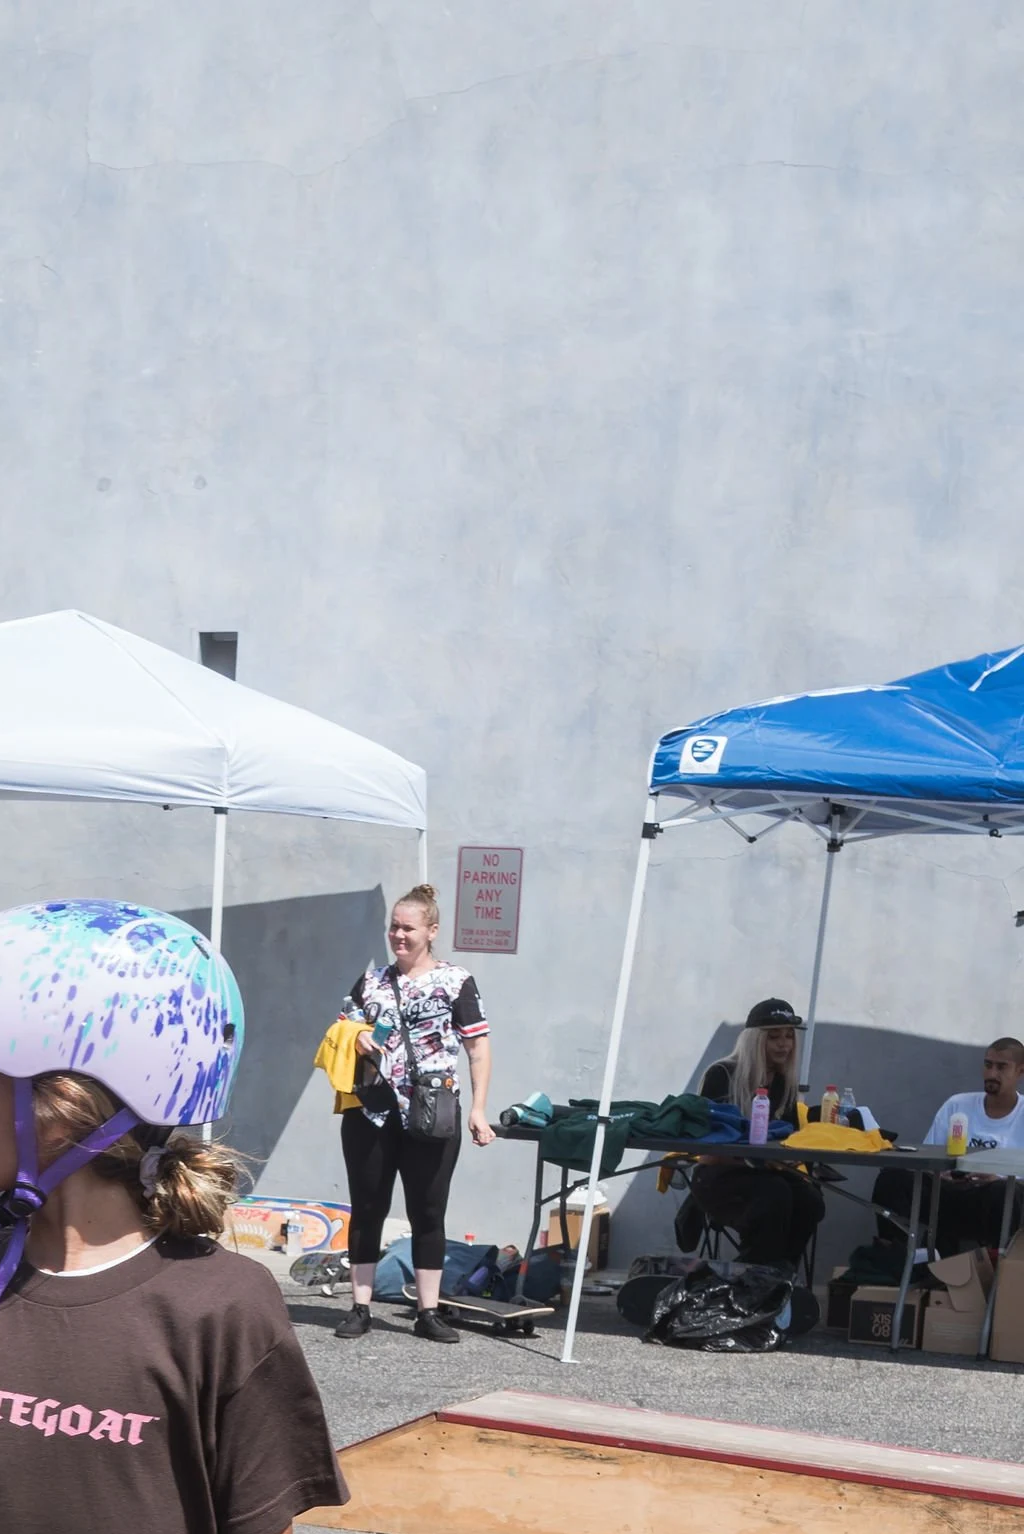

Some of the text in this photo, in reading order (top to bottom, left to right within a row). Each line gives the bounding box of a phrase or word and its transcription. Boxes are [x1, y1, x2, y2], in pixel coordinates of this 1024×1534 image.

[482, 853, 500, 867] NO
[463, 871, 517, 885] PARKING
[475, 889, 503, 902] ANY
[474, 906, 503, 920] TIME
